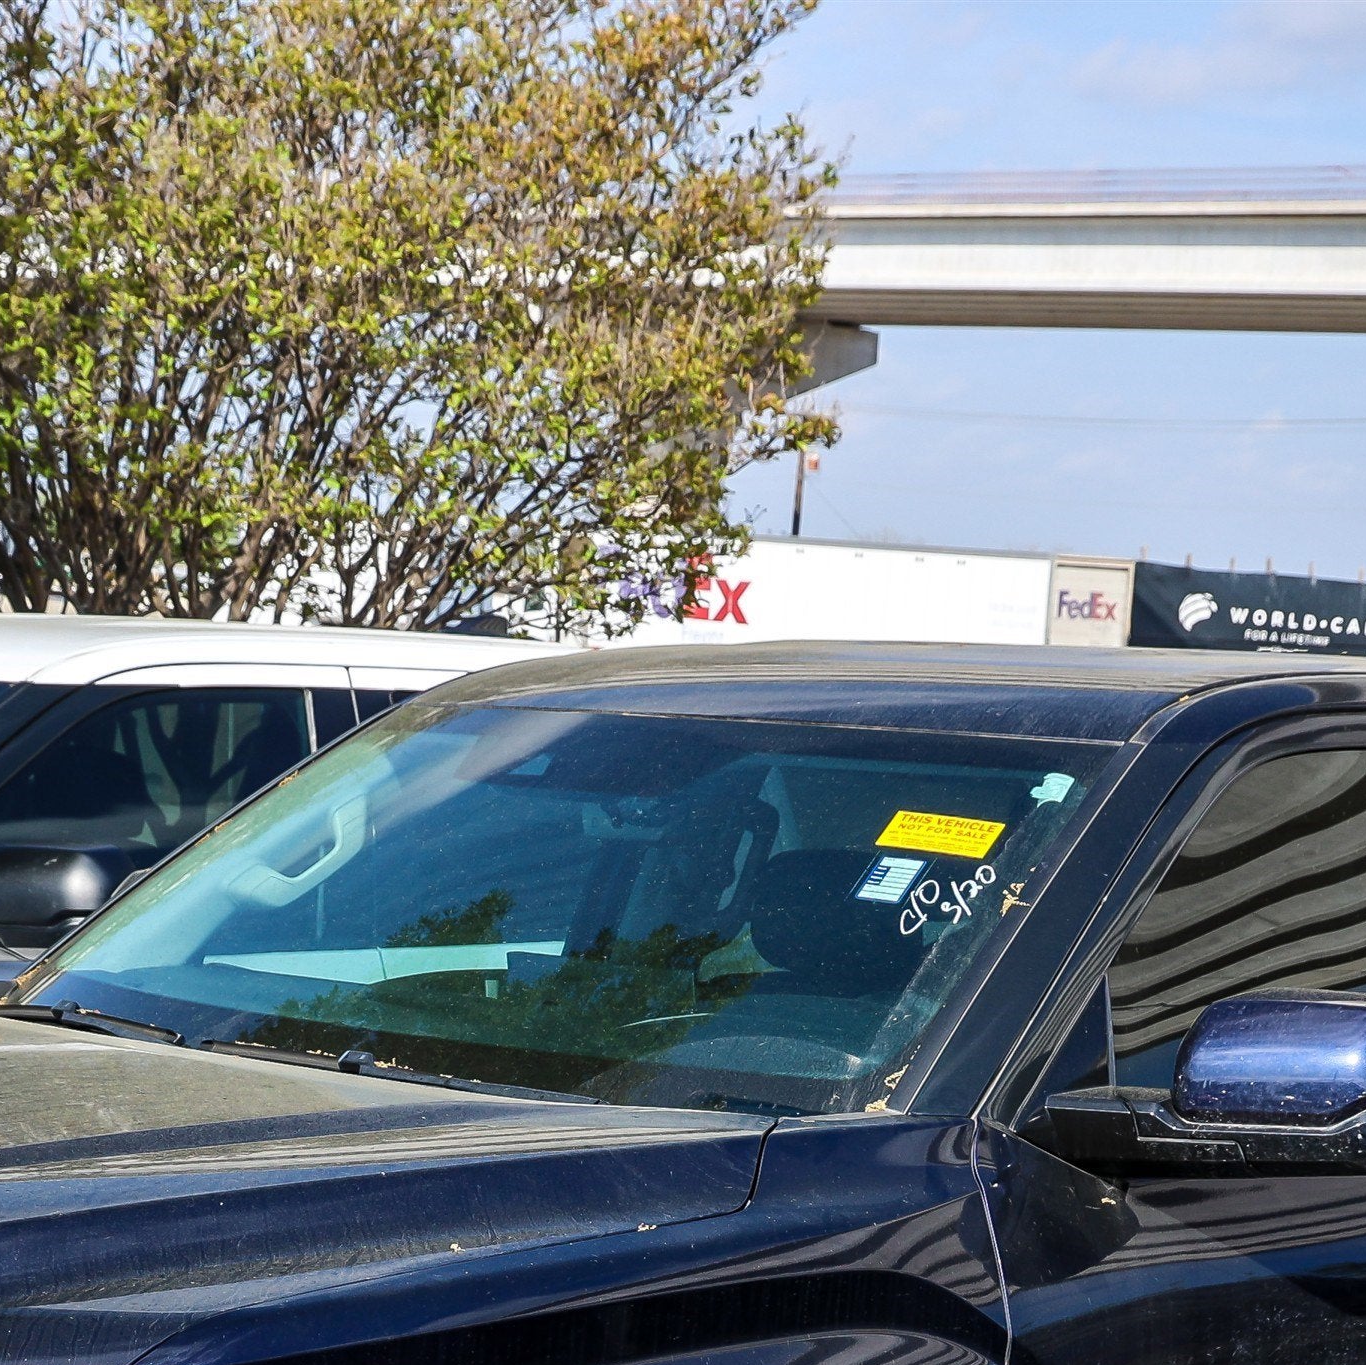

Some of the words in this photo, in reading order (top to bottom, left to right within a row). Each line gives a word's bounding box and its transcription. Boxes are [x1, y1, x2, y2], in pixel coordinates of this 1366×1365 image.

[1058, 590, 1117, 620] FedEx
[1243, 628, 1268, 642] FOR
[1269, 631, 1279, 642] A
[897, 823, 924, 831] NOT
[925, 826, 952, 835] FOR
[955, 829, 989, 840] SALE
[900, 813, 934, 824] THIS
[936, 817, 998, 834] VEHICLE
